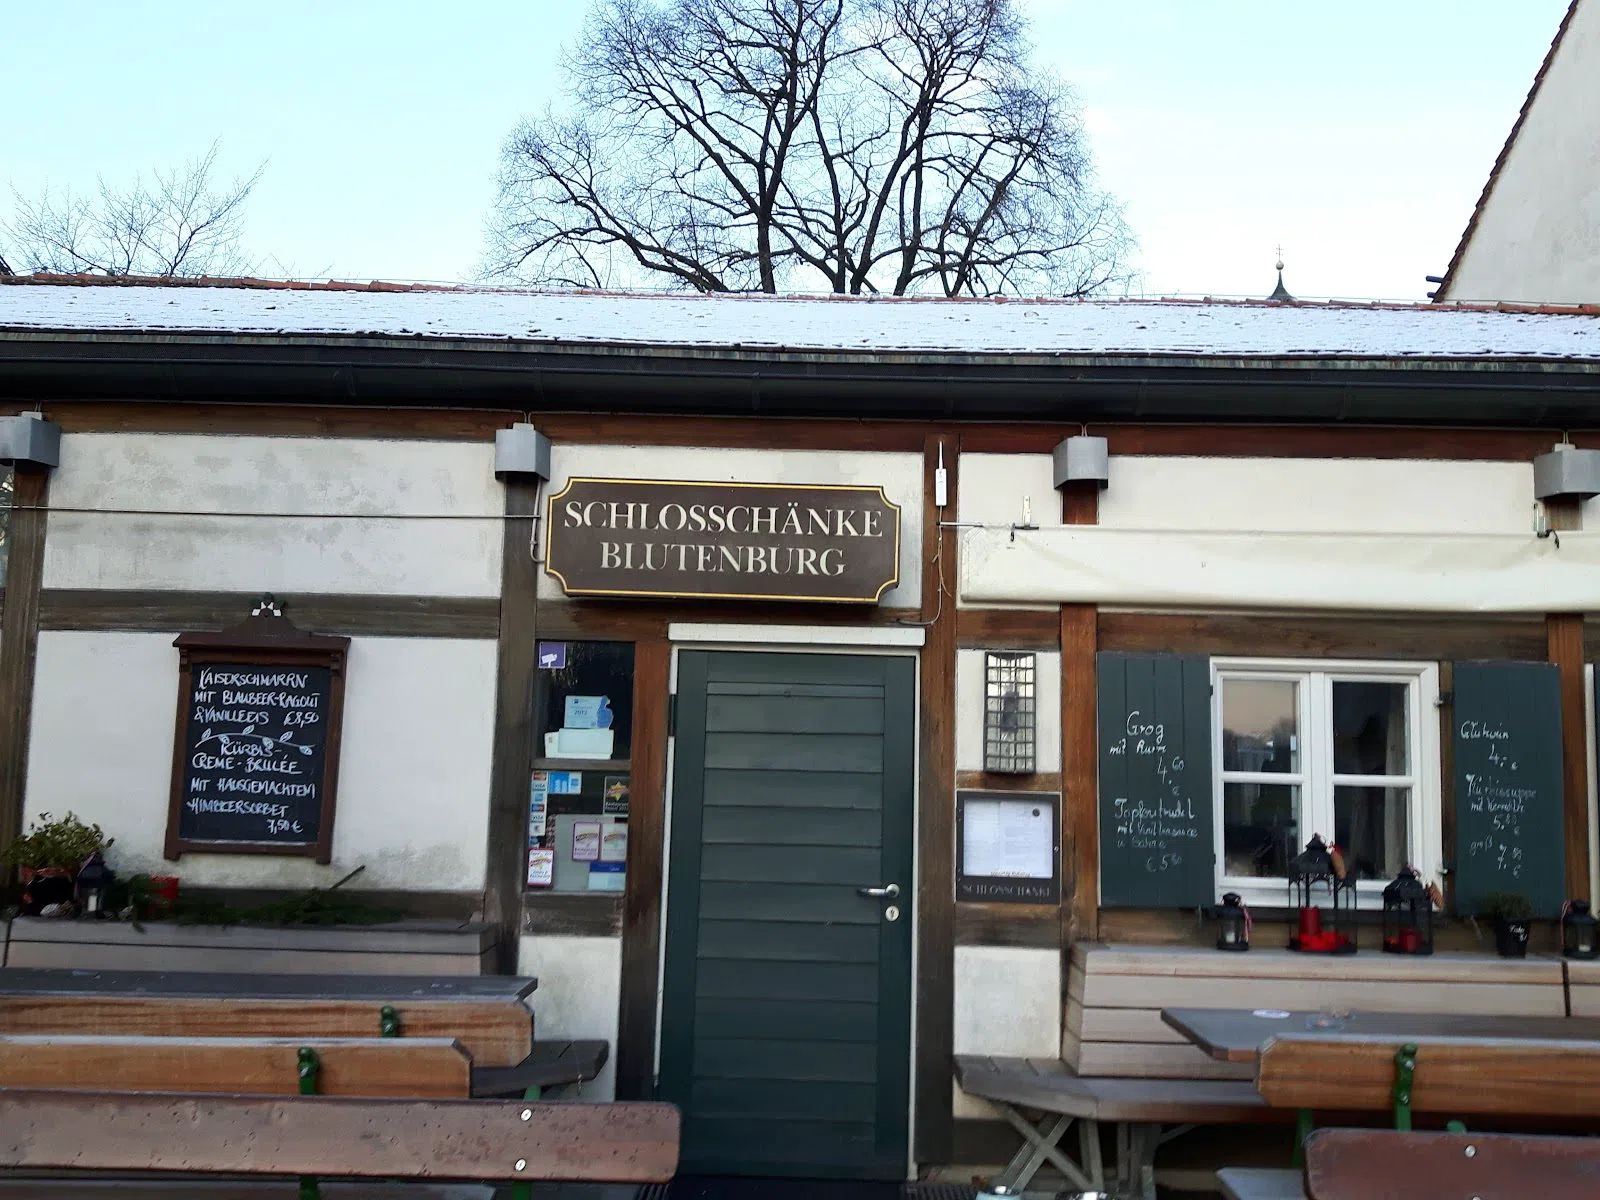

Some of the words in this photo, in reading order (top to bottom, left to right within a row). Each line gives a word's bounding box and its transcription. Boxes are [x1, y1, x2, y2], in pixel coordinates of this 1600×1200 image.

[564, 500, 883, 537] SCHLOSSCHÄNKE
[600, 541, 846, 576] BLUTENBURG
[199, 667, 308, 689] KAISERSCHMARRN
[195, 691, 216, 703] MIT
[1126, 711, 1164, 743] Grog
[1109, 738, 1127, 755] mit
[1136, 739, 1167, 755] Rum
[190, 777, 211, 793] MIT
[266, 819, 290, 835] 7,50
[1117, 822, 1133, 835] mit
